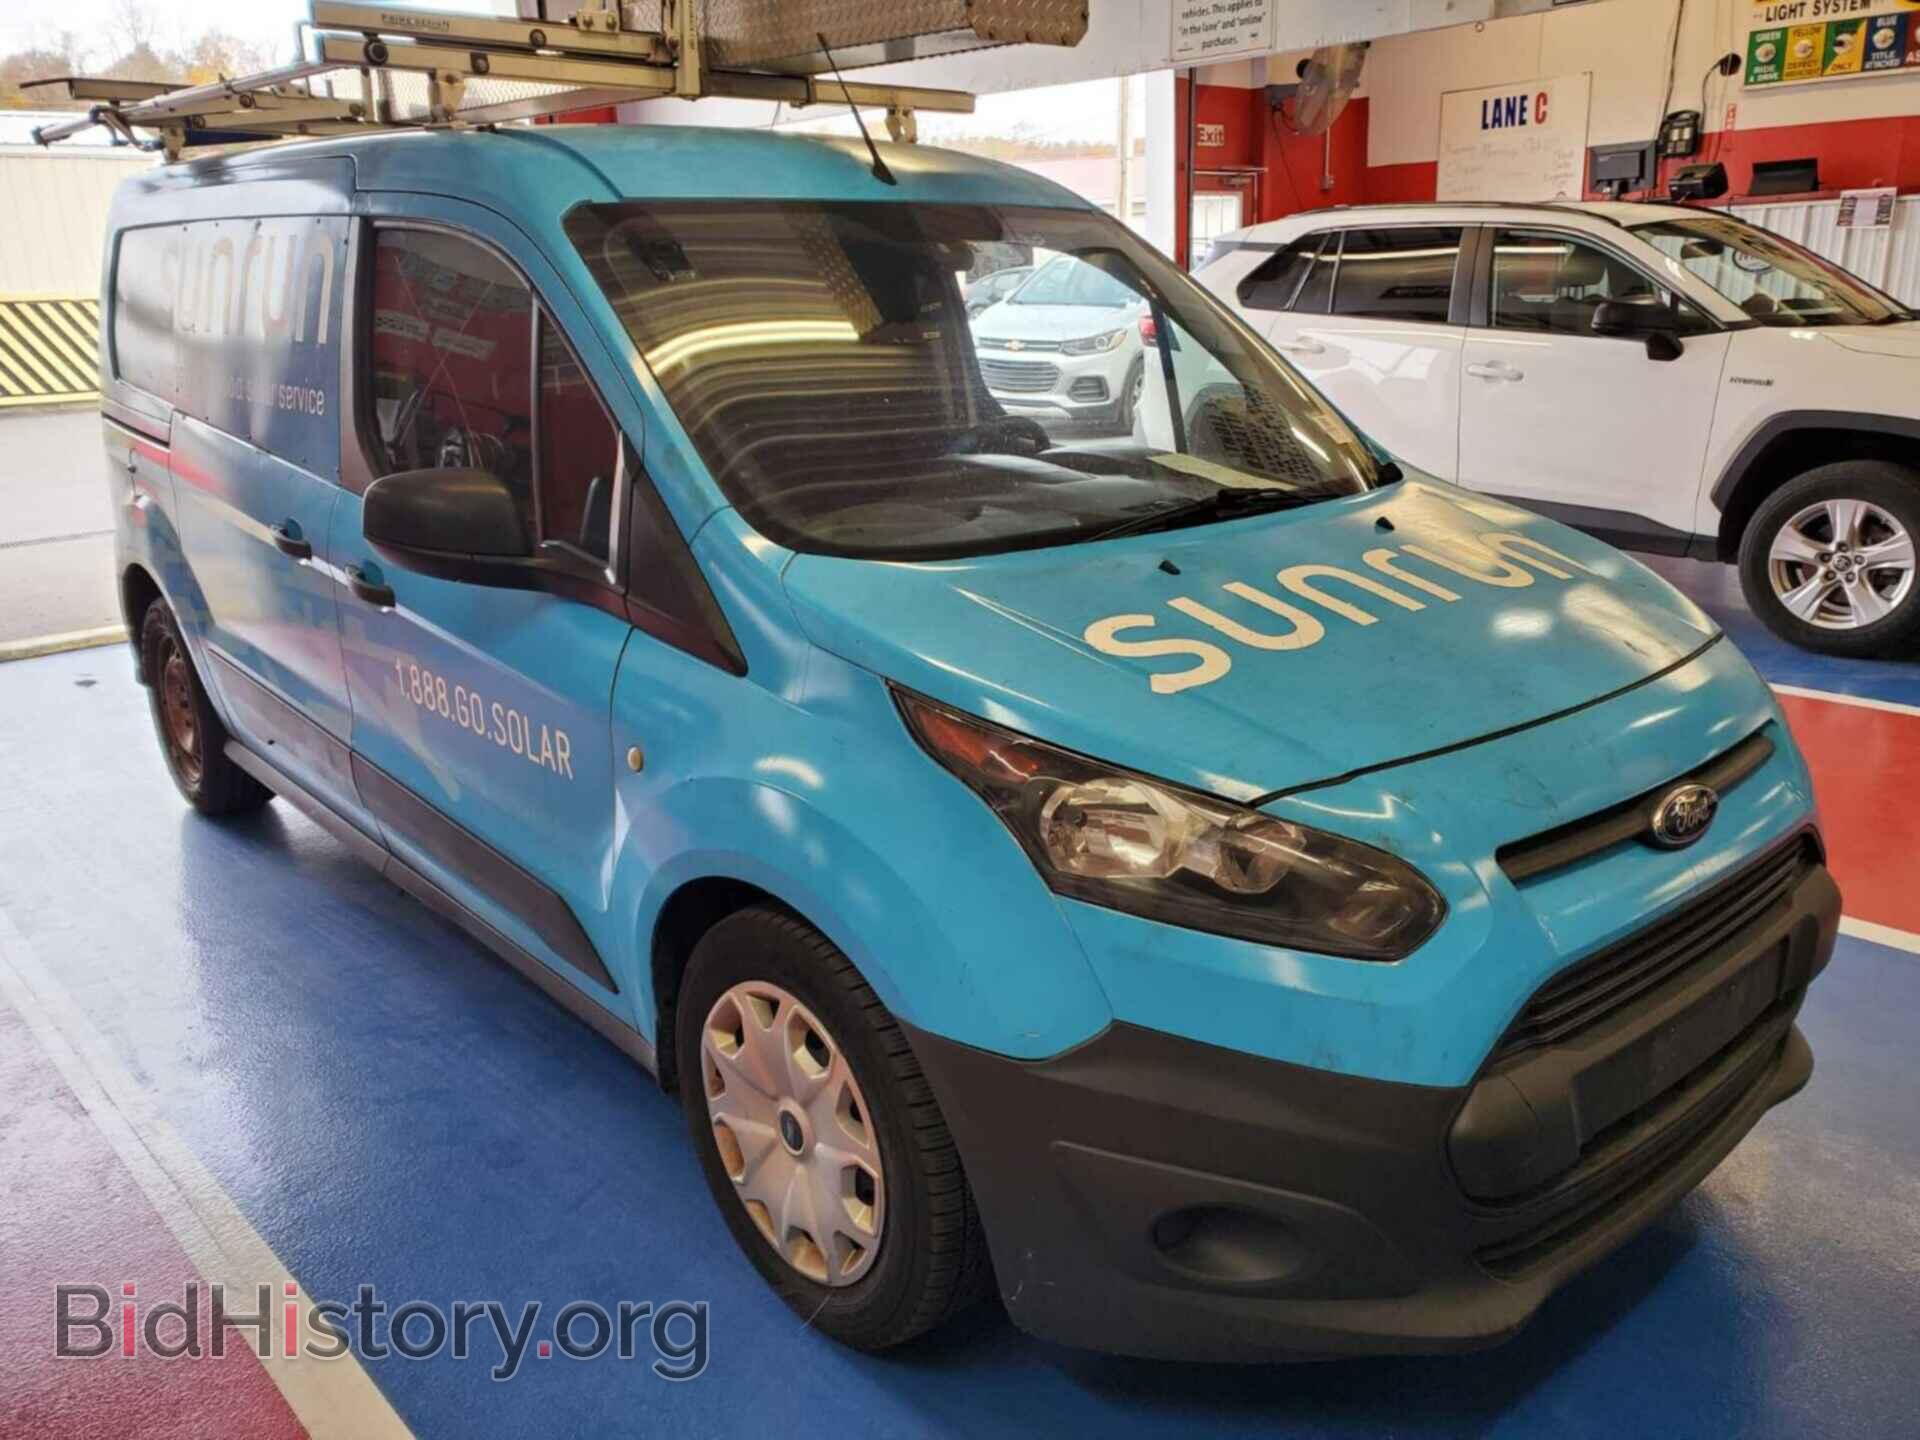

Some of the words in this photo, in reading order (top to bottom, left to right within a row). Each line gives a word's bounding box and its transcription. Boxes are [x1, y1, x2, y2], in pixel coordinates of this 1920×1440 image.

[1212, 3, 1226, 14] This
[1766, 2, 1807, 23] LIGHT
[1812, 0, 1872, 17] SYSTEM
[1189, 24, 1201, 34] the
[1222, 17, 1236, 29] and
[1755, 31, 1782, 43] GREEN
[1871, 50, 1897, 61] TITLE
[1481, 94, 1528, 131] LANE
[1534, 91, 1549, 125] C
[278, 375, 326, 417] service
[395, 656, 573, 781] 1.888.GO.SOLAR
[1669, 794, 1711, 833] Ford
